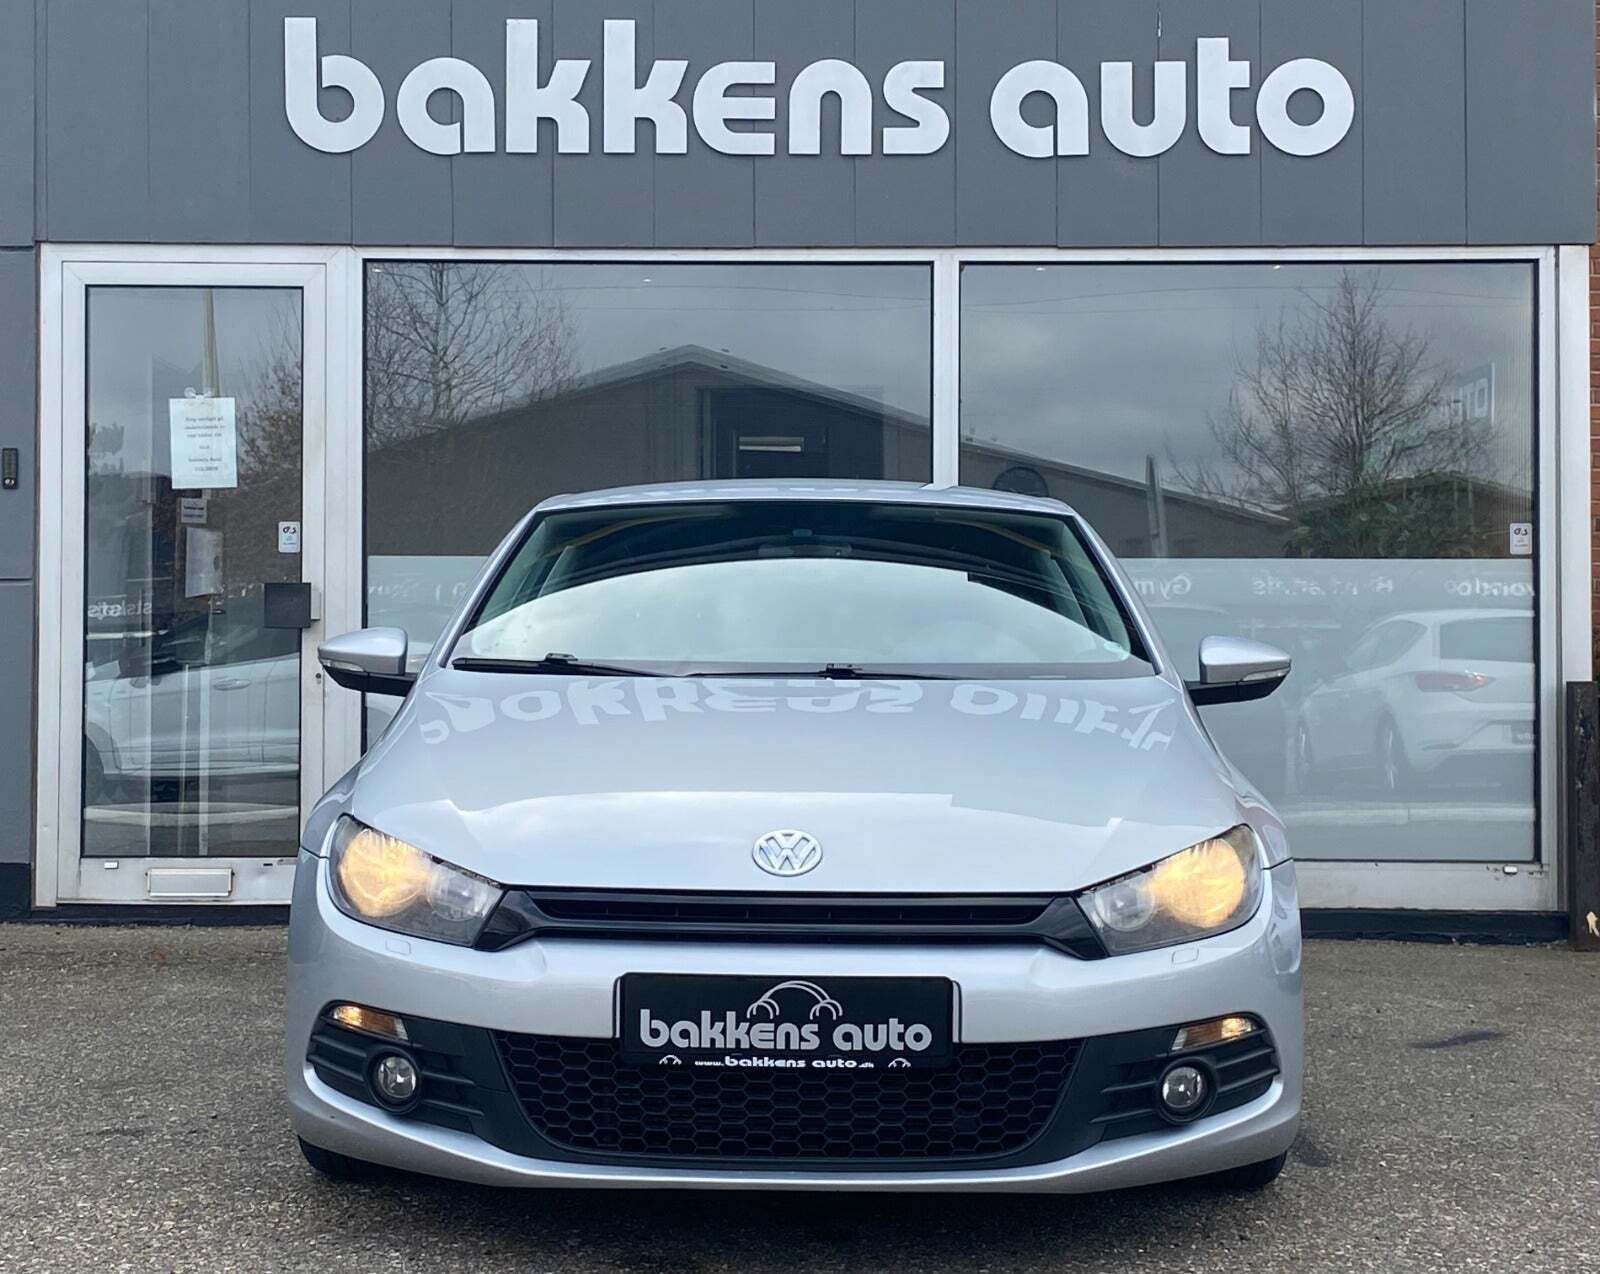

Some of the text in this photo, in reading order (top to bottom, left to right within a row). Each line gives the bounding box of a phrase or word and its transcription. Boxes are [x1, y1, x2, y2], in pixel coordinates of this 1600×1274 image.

[284, 17, 1355, 158] bakkens auto
[640, 1008, 932, 1052] bakkens auto
